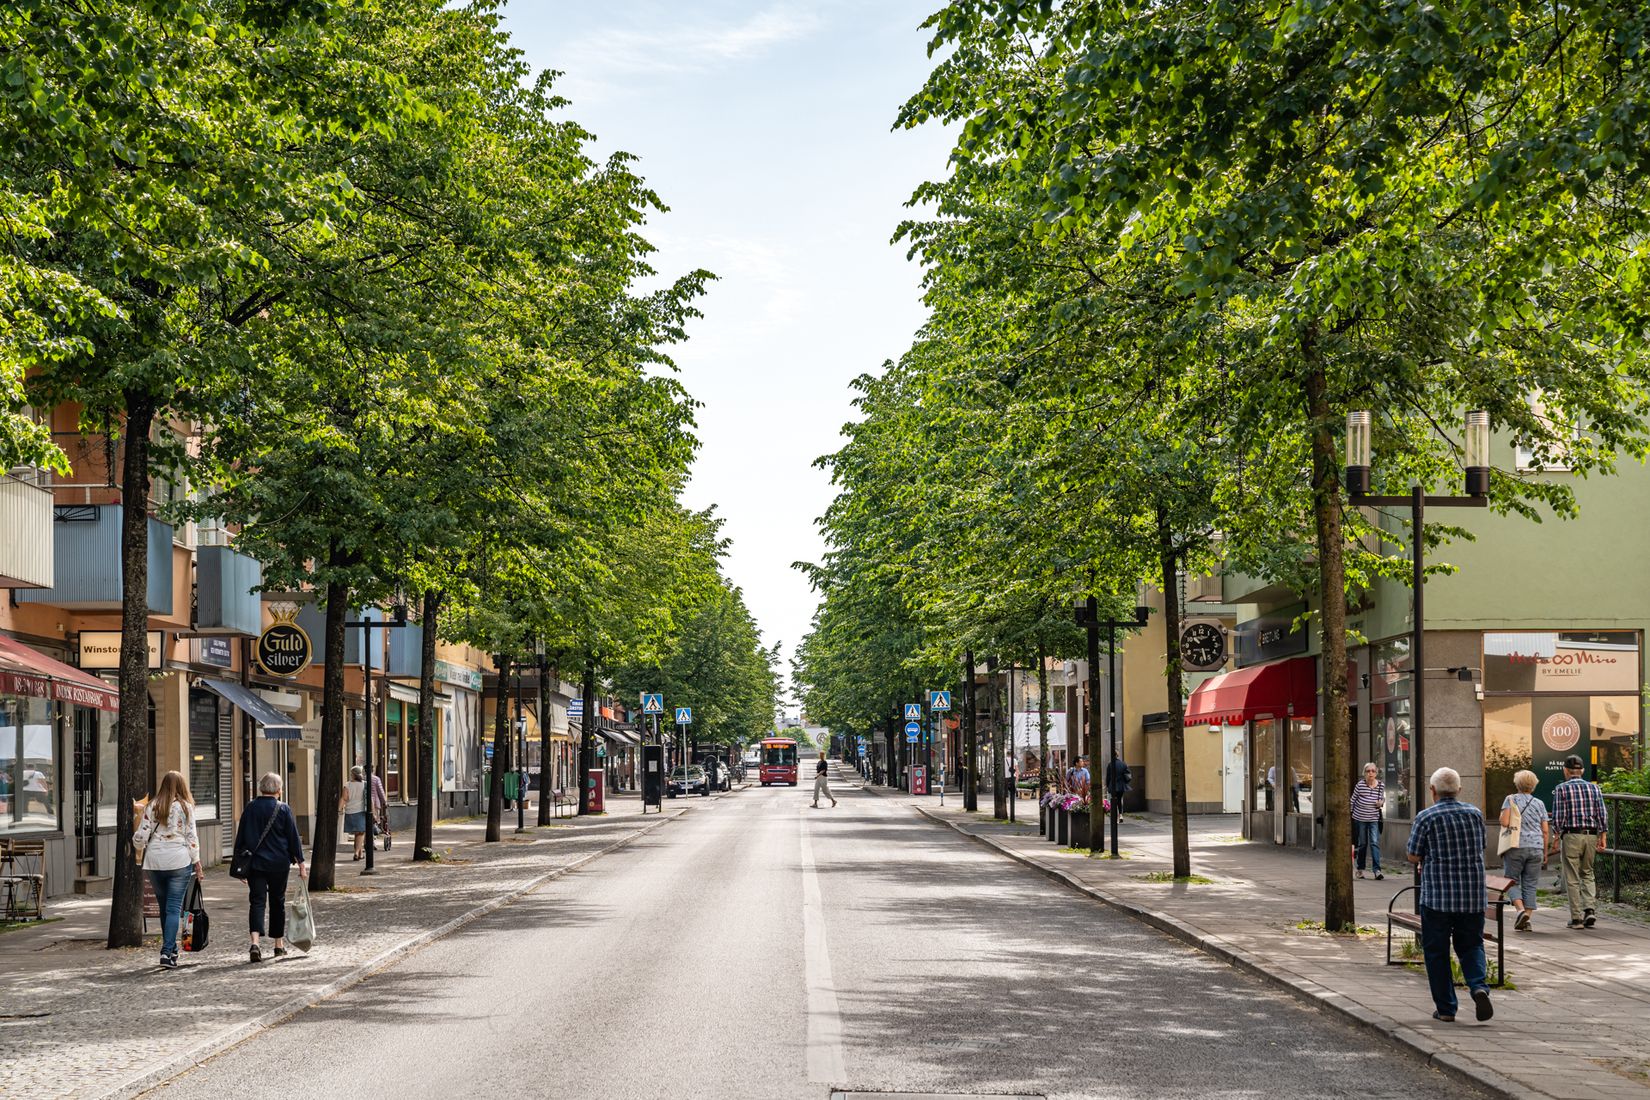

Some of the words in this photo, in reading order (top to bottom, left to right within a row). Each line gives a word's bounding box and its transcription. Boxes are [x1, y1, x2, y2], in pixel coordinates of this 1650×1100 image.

[264, 632, 303, 652] Guld
[266, 652, 303, 666] silver
[1552, 726, 1572, 737] 100
